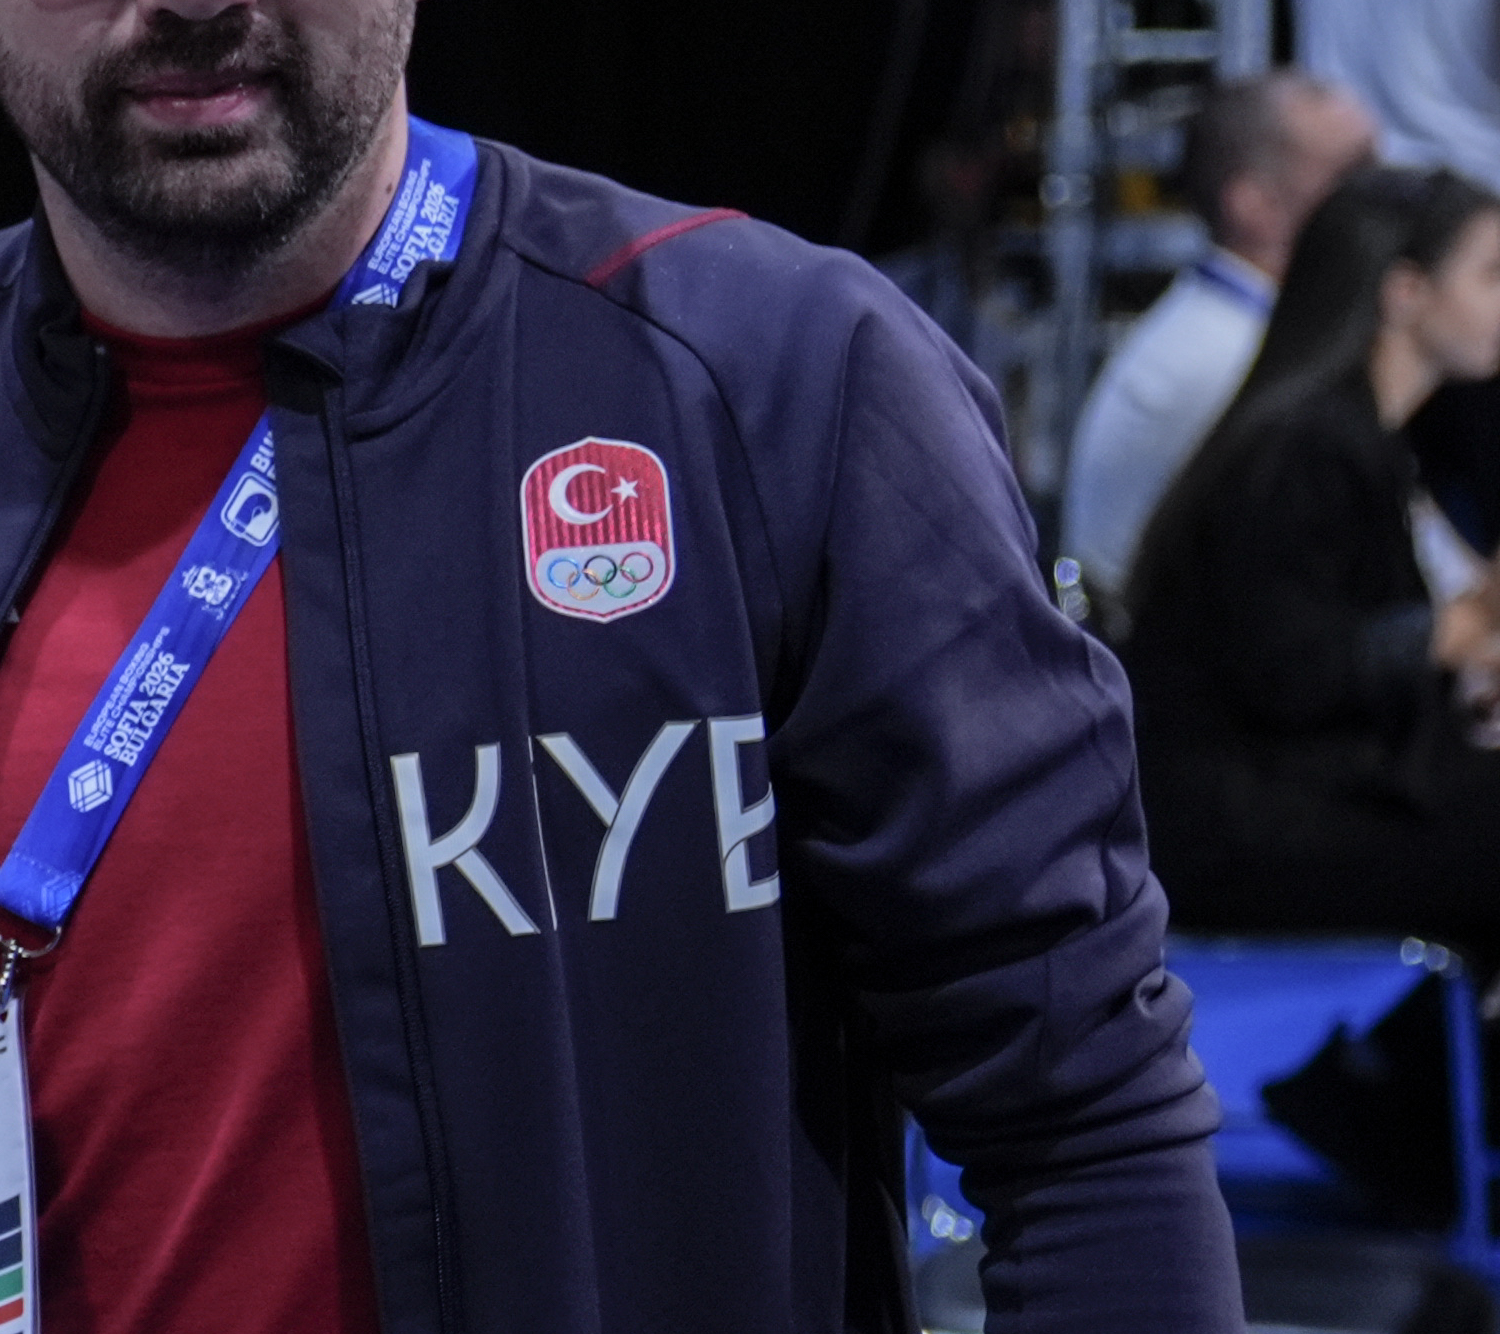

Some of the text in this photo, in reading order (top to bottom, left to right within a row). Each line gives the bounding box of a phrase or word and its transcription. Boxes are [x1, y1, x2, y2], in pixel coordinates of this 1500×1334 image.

[390, 180, 445, 283] SOFIA 2026
[420, 195, 460, 262] GARIA
[104, 651, 174, 760] SOFIA 2026
[118, 664, 191, 767] BULGARIA
[390, 711, 781, 948] KYE
